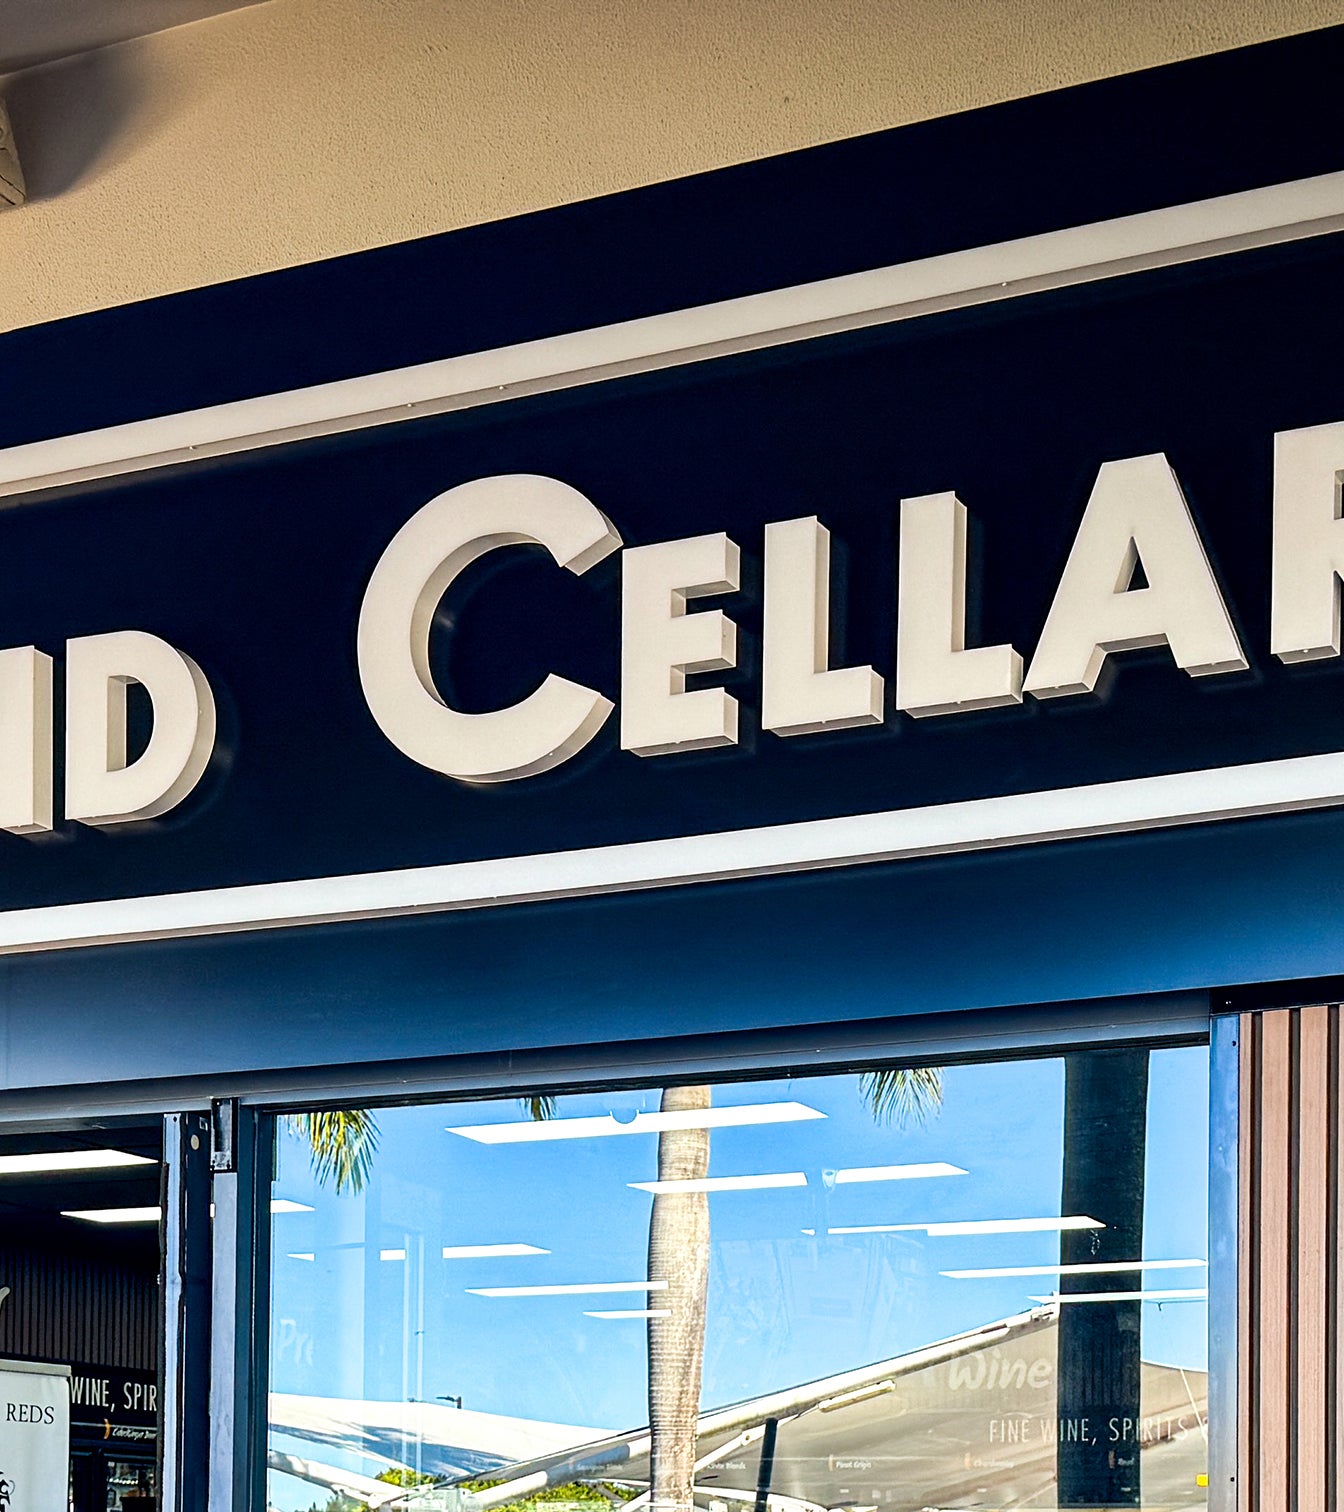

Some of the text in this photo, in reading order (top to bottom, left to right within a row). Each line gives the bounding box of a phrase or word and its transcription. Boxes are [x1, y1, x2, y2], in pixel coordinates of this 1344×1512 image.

[948, 1352, 1052, 1391] Wine
[70, 1376, 115, 1413] WINE,
[5, 1402, 55, 1426] REDS
[989, 1418, 1029, 1443] FINE
[1109, 1417, 1188, 1442] SPIRITS
